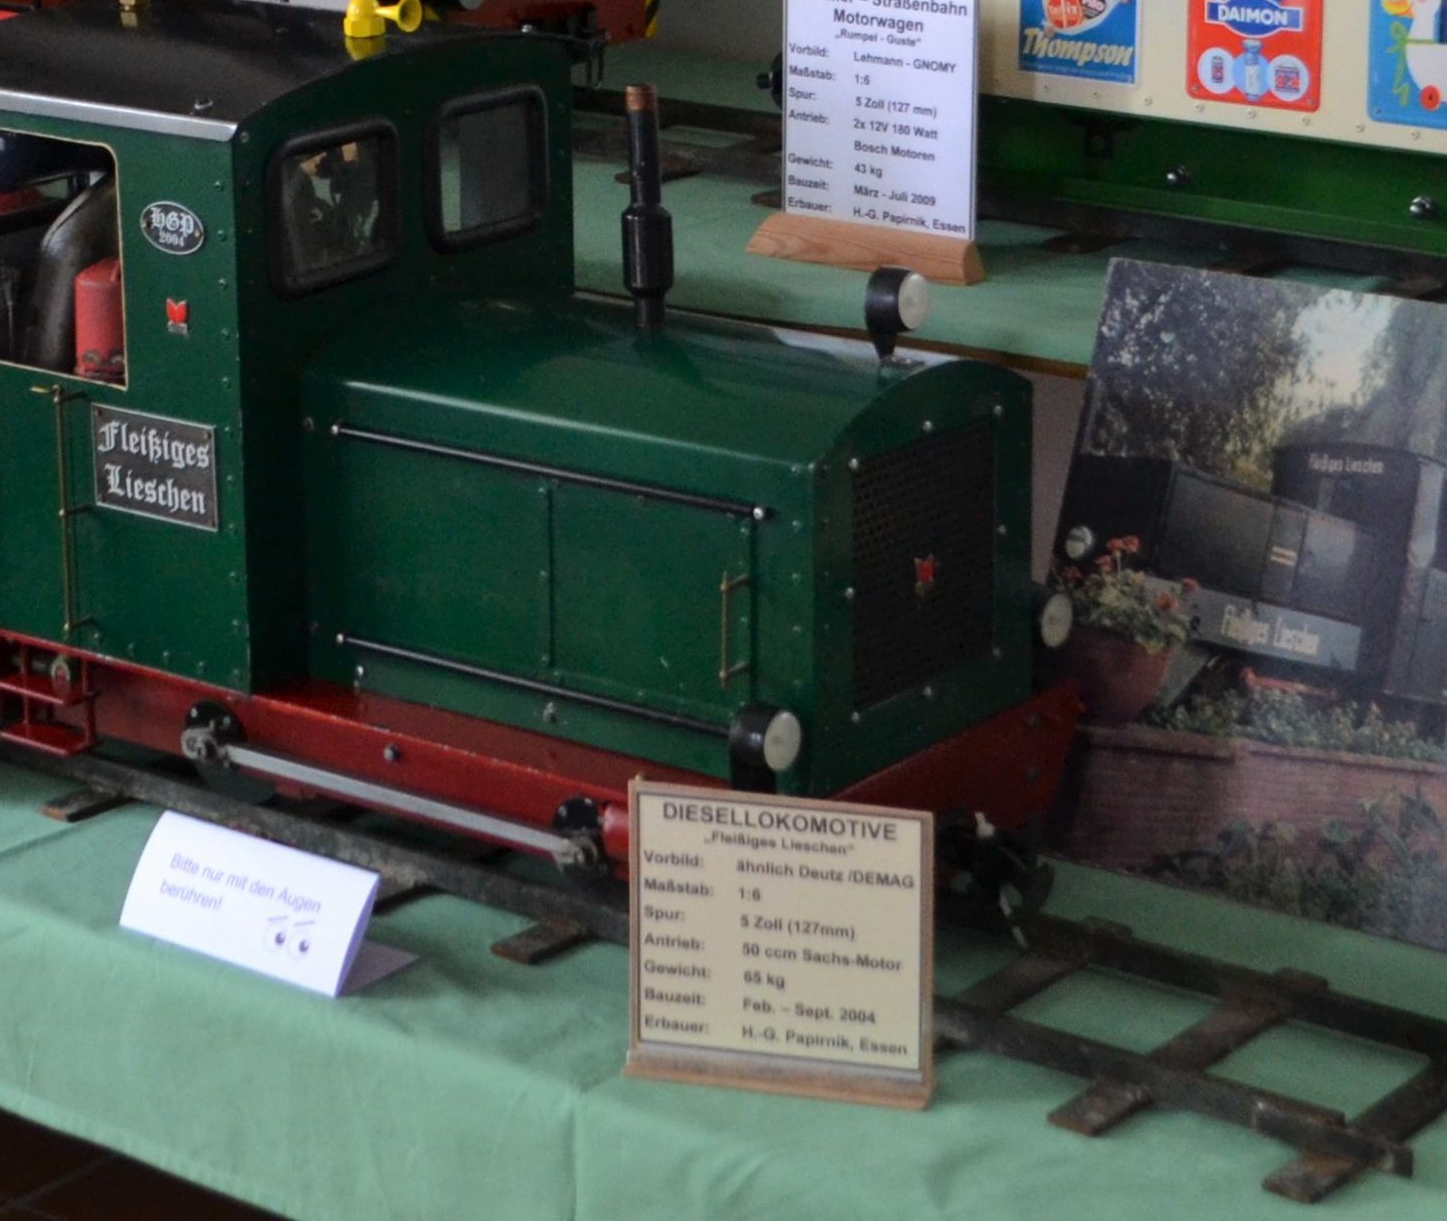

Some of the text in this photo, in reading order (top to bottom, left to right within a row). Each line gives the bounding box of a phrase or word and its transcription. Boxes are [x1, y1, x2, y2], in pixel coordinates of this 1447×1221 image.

[833, 9, 924, 34] Motorwagen
[1218, 4, 1289, 26] DAIMON
[789, 43, 829, 58] Vorbild:
[854, 51, 903, 68] Lehmann
[913, 58, 956, 74] GNOMY
[1023, 27, 1135, 67] Thompson
[789, 65, 870, 86] Maßstab: 1:6
[789, 87, 938, 118] Spur: 5 Zoll (127 mm)
[789, 108, 939, 140] Antrieb: 2x 12V 180 Watt
[788, 153, 883, 178] Gewicht: 43 kg
[854, 140, 935, 162] Bosch Motoren
[788, 175, 829, 191] Bauzeit:
[854, 185, 878, 199] März
[889, 189, 908, 203] Juli
[911, 192, 936, 206] 2009
[788, 196, 832, 213] Erbauer:
[932, 219, 966, 233] Essen
[158, 230, 185, 248] 2004
[97, 420, 211, 470] Fleißiges
[105, 462, 207, 515] Lieschen
[662, 801, 897, 842] DIESELLOKOMOTIVE
[170, 852, 322, 914] Bitte nur mit den Augen
[643, 850, 915, 890] Vorbild: ähnlich Deutz /DEMAG
[159, 880, 224, 912] berühren!
[643, 878, 761, 902] Maßstab: 1:6
[643, 904, 855, 941] Spur: 5 Zoll (127mm)
[643, 932, 705, 951] Antrieb:
[742, 942, 760, 957] 50
[765, 947, 796, 961] ccm
[643, 959, 712, 980] Gewicht:
[766, 972, 785, 990] kg
[643, 987, 706, 1006] Bauzeit:
[742, 998, 775, 1014] Feb.
[794, 1003, 834, 1022] Sept.
[839, 1008, 876, 1024] 2004
[643, 1014, 709, 1034] Erbauer:
[859, 1038, 907, 1056] Essen
